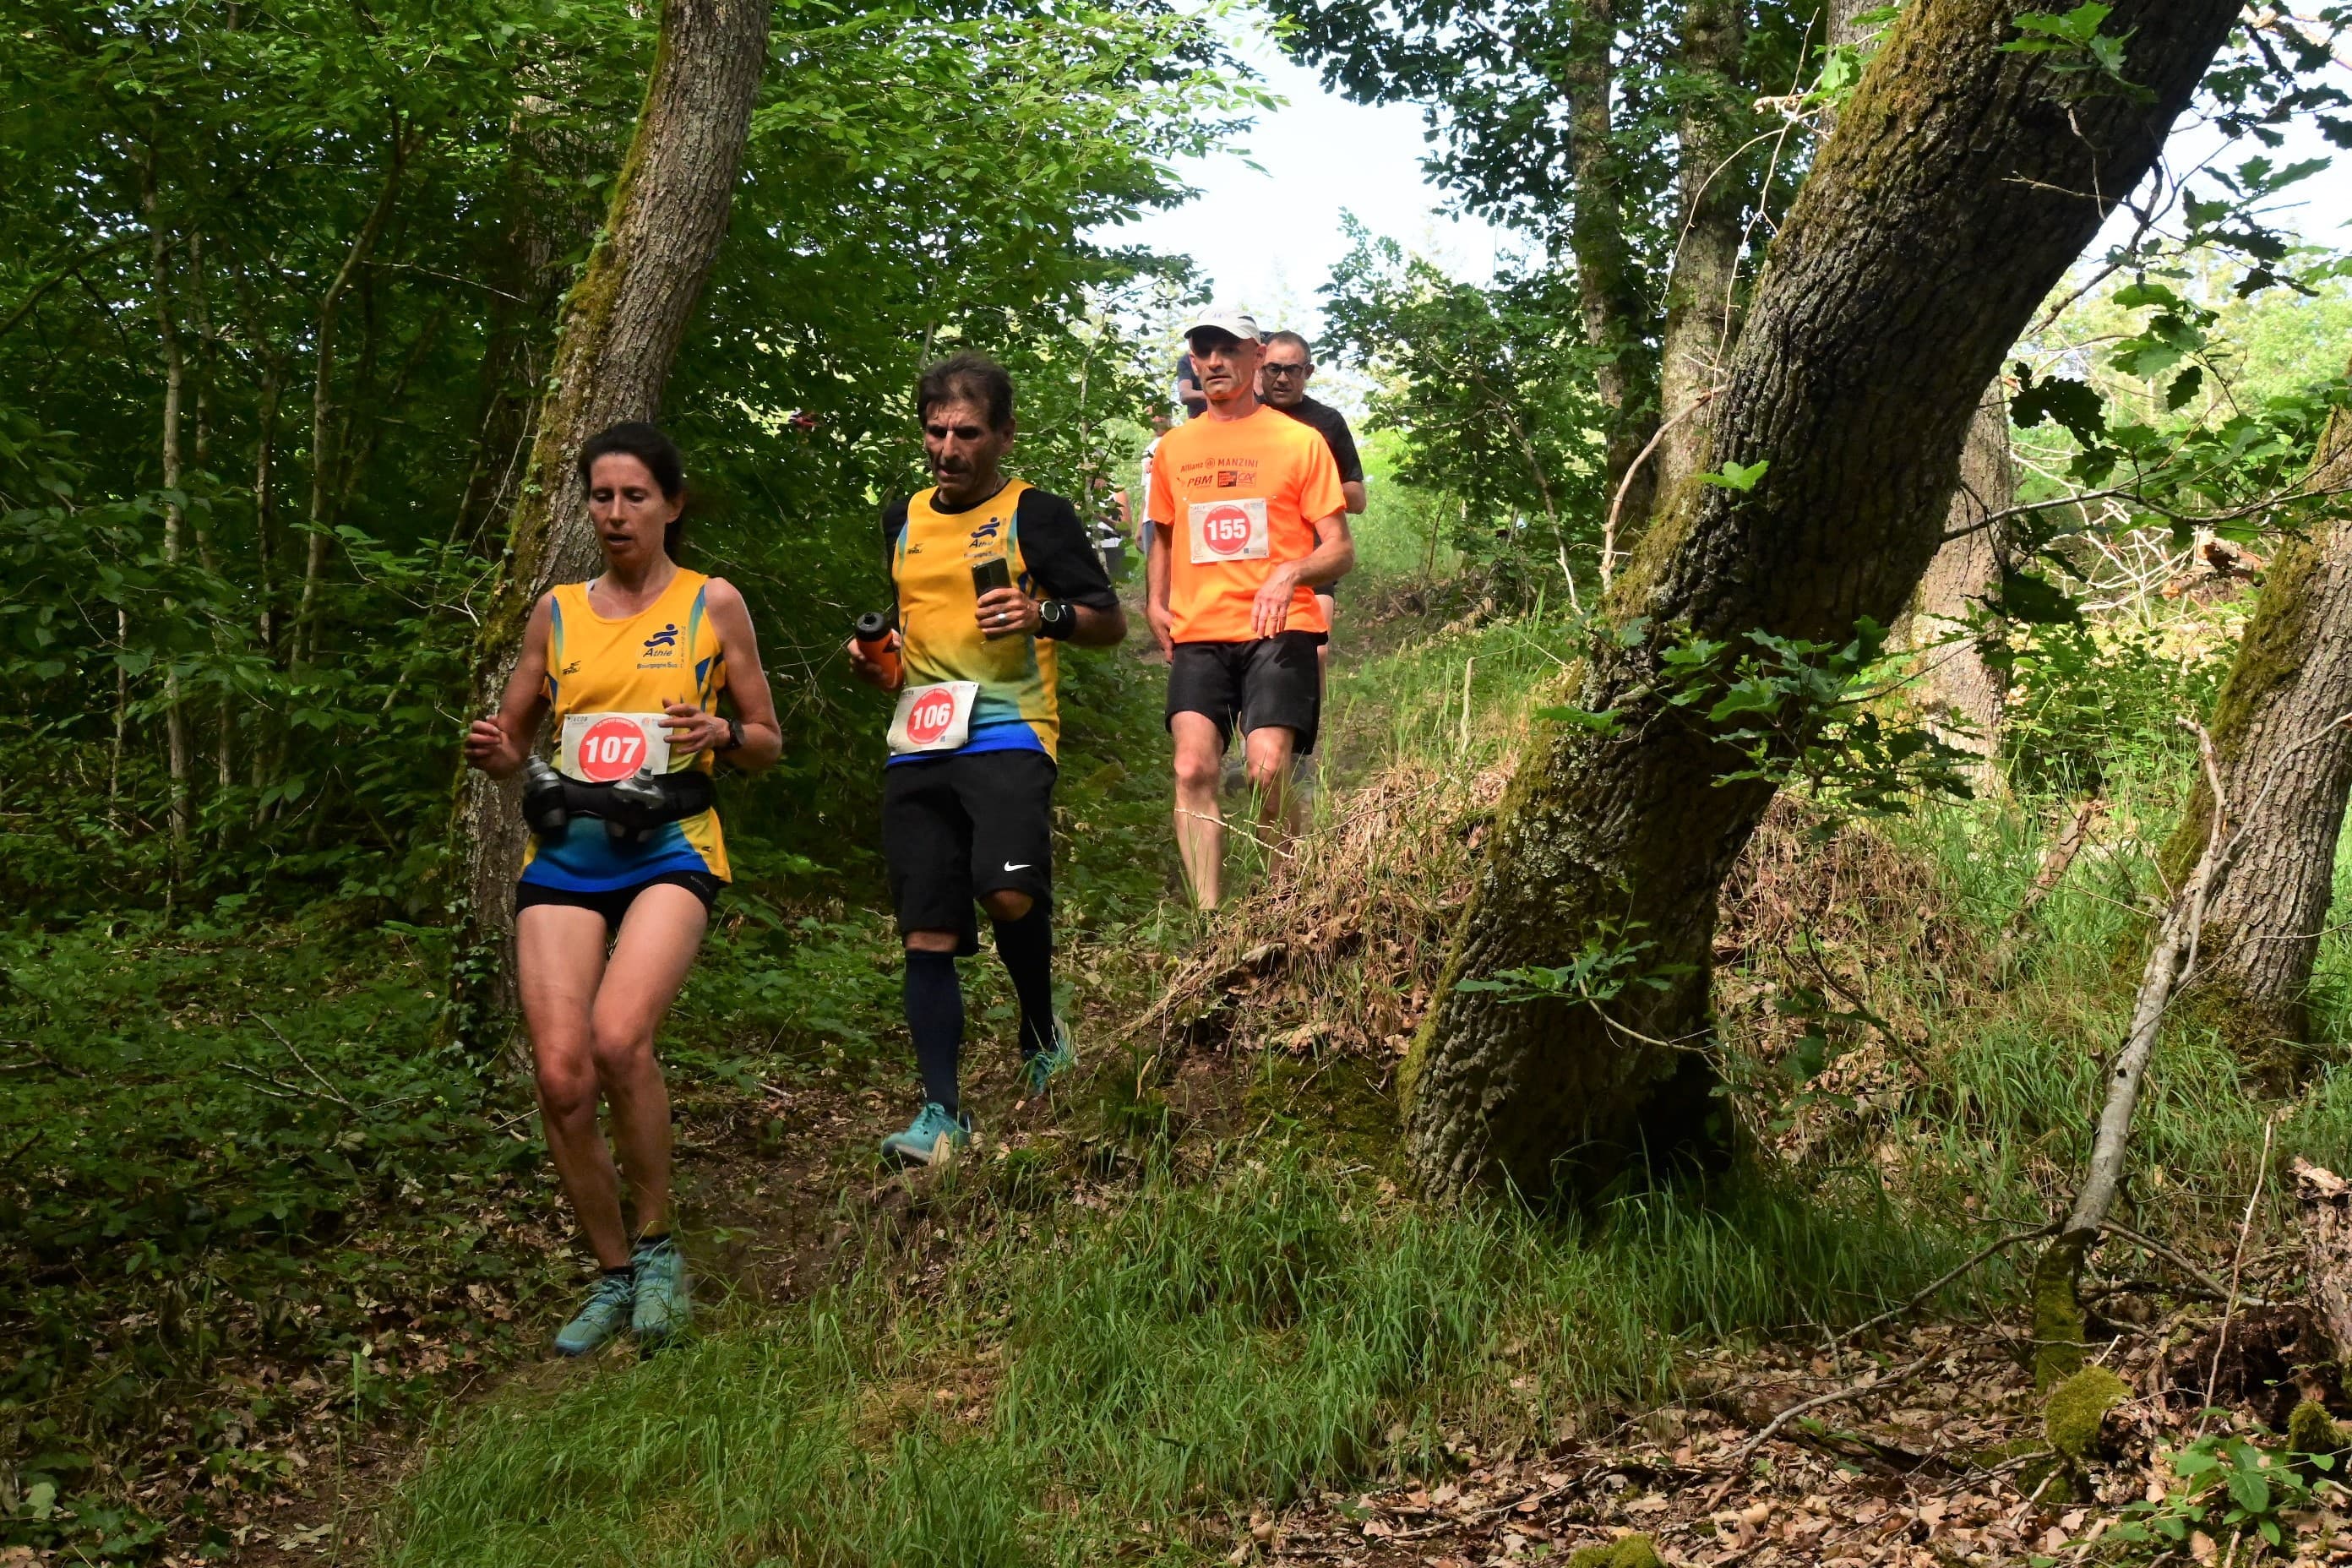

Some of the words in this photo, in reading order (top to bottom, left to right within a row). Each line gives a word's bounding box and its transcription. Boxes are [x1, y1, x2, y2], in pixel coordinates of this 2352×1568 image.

[1180, 462, 1203, 473] Allianz
[1217, 457, 1259, 468] MANZINI
[1187, 475, 1213, 487] PBM
[1206, 518, 1247, 541] 155
[913, 703, 951, 730] 106
[585, 736, 641, 764] 107
